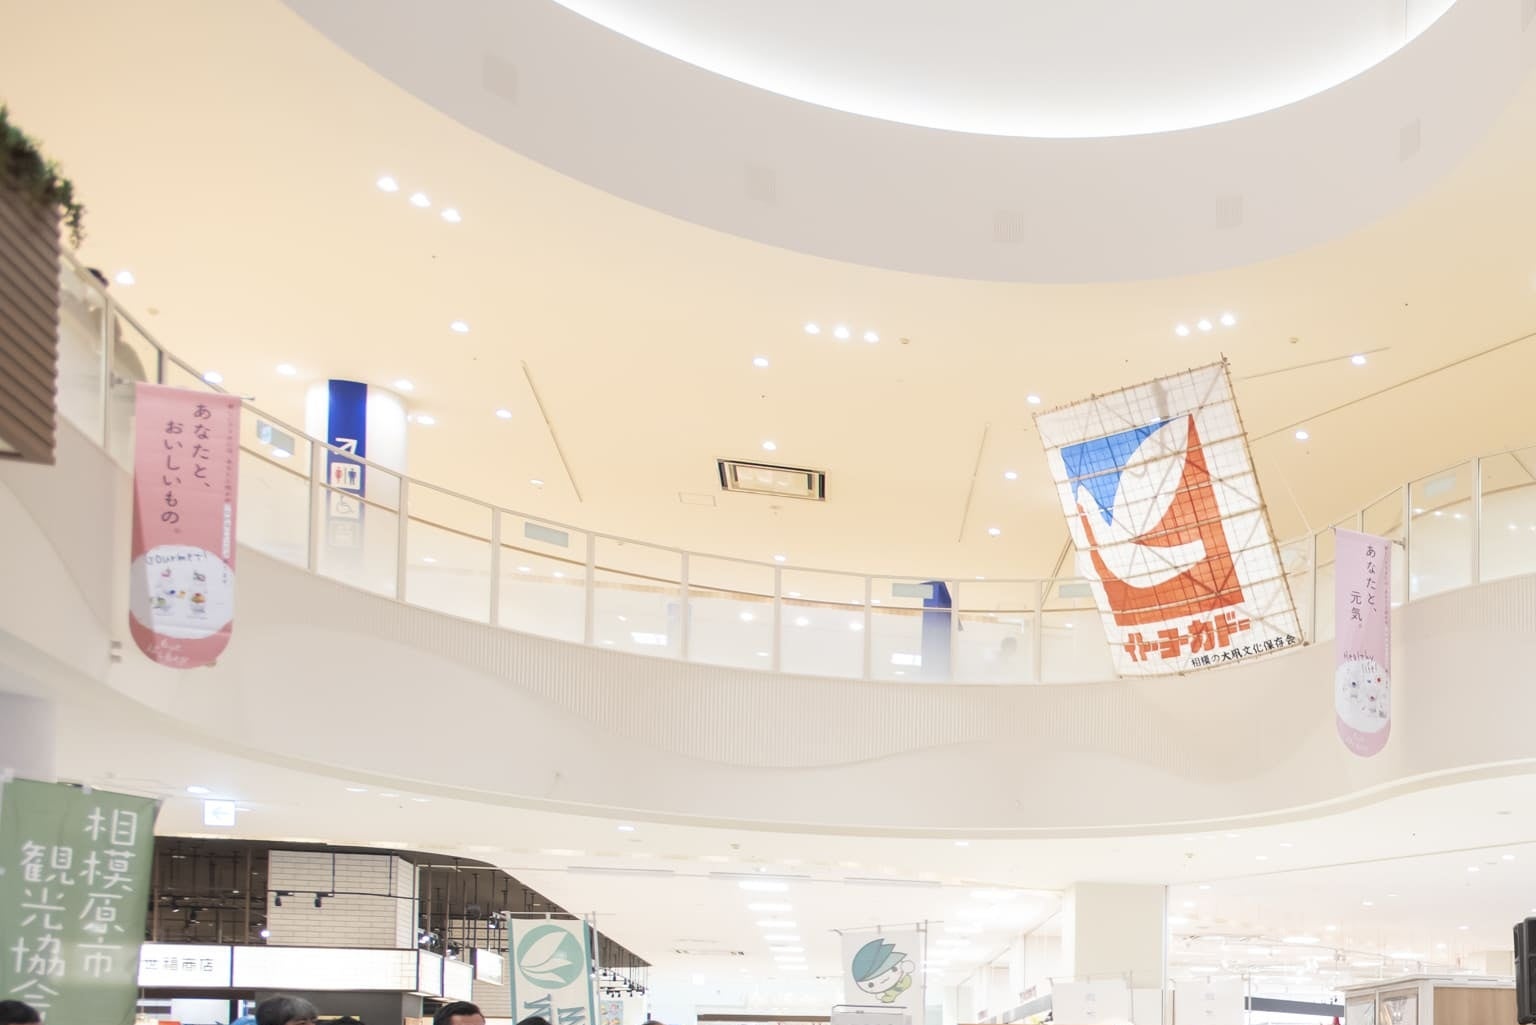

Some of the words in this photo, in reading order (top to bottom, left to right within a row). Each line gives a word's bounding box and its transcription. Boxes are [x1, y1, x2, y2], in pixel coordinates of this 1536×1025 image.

[161, 420, 184, 534] おいしいもの。
[192, 404, 212, 488] あなたと、
[1365, 545, 1377, 613] あなたと、
[79, 806, 138, 977] 相模原市
